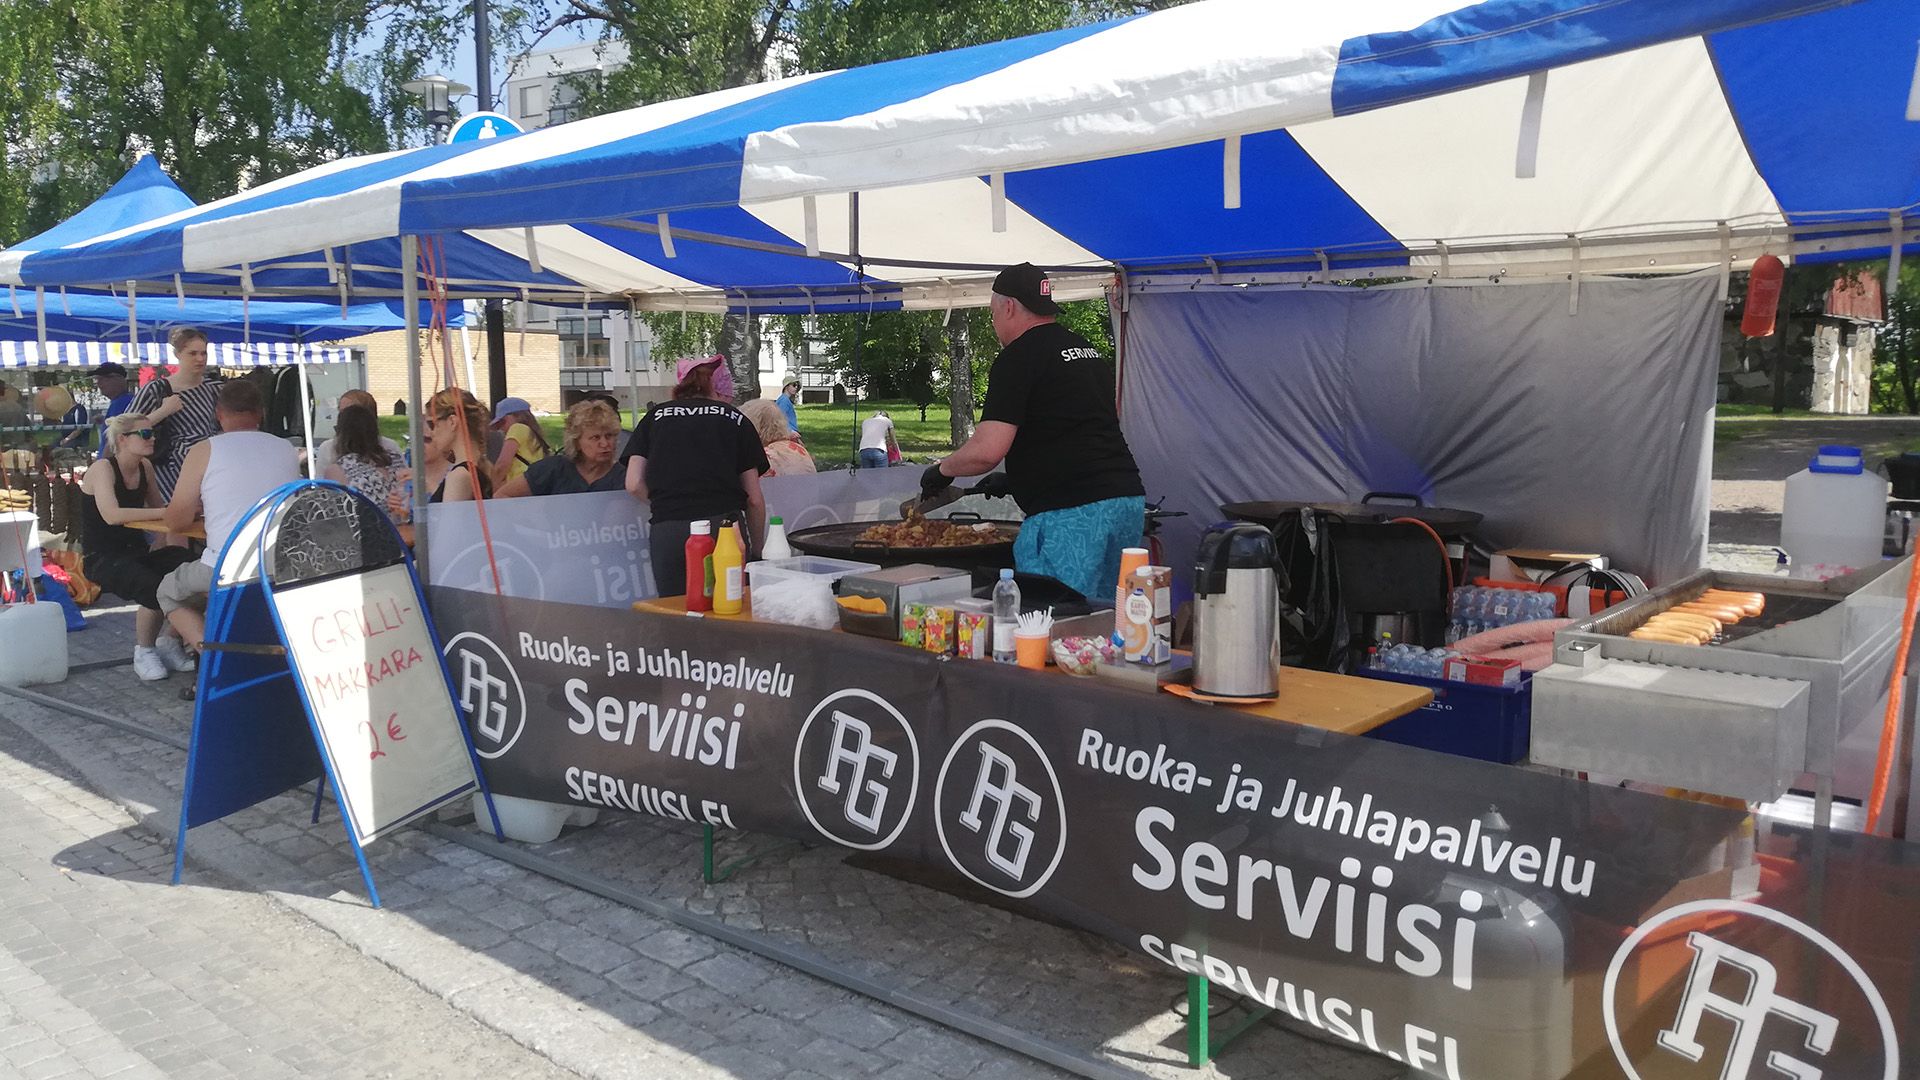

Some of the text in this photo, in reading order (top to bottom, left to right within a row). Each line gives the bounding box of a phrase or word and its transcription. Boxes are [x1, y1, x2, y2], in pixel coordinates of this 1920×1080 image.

[654, 405, 744, 426] SERVIISI.FI
[312, 598, 411, 652] GRILLI-
[315, 647, 423, 708] MAKKARA
[519, 631, 794, 698] Ruoka- ja Juhlapalvelu
[564, 678, 745, 770] Serviisi
[1077, 728, 1596, 897] Ruoka- ja Juhlapalvelu
[1131, 806, 1483, 991] Serviisi
